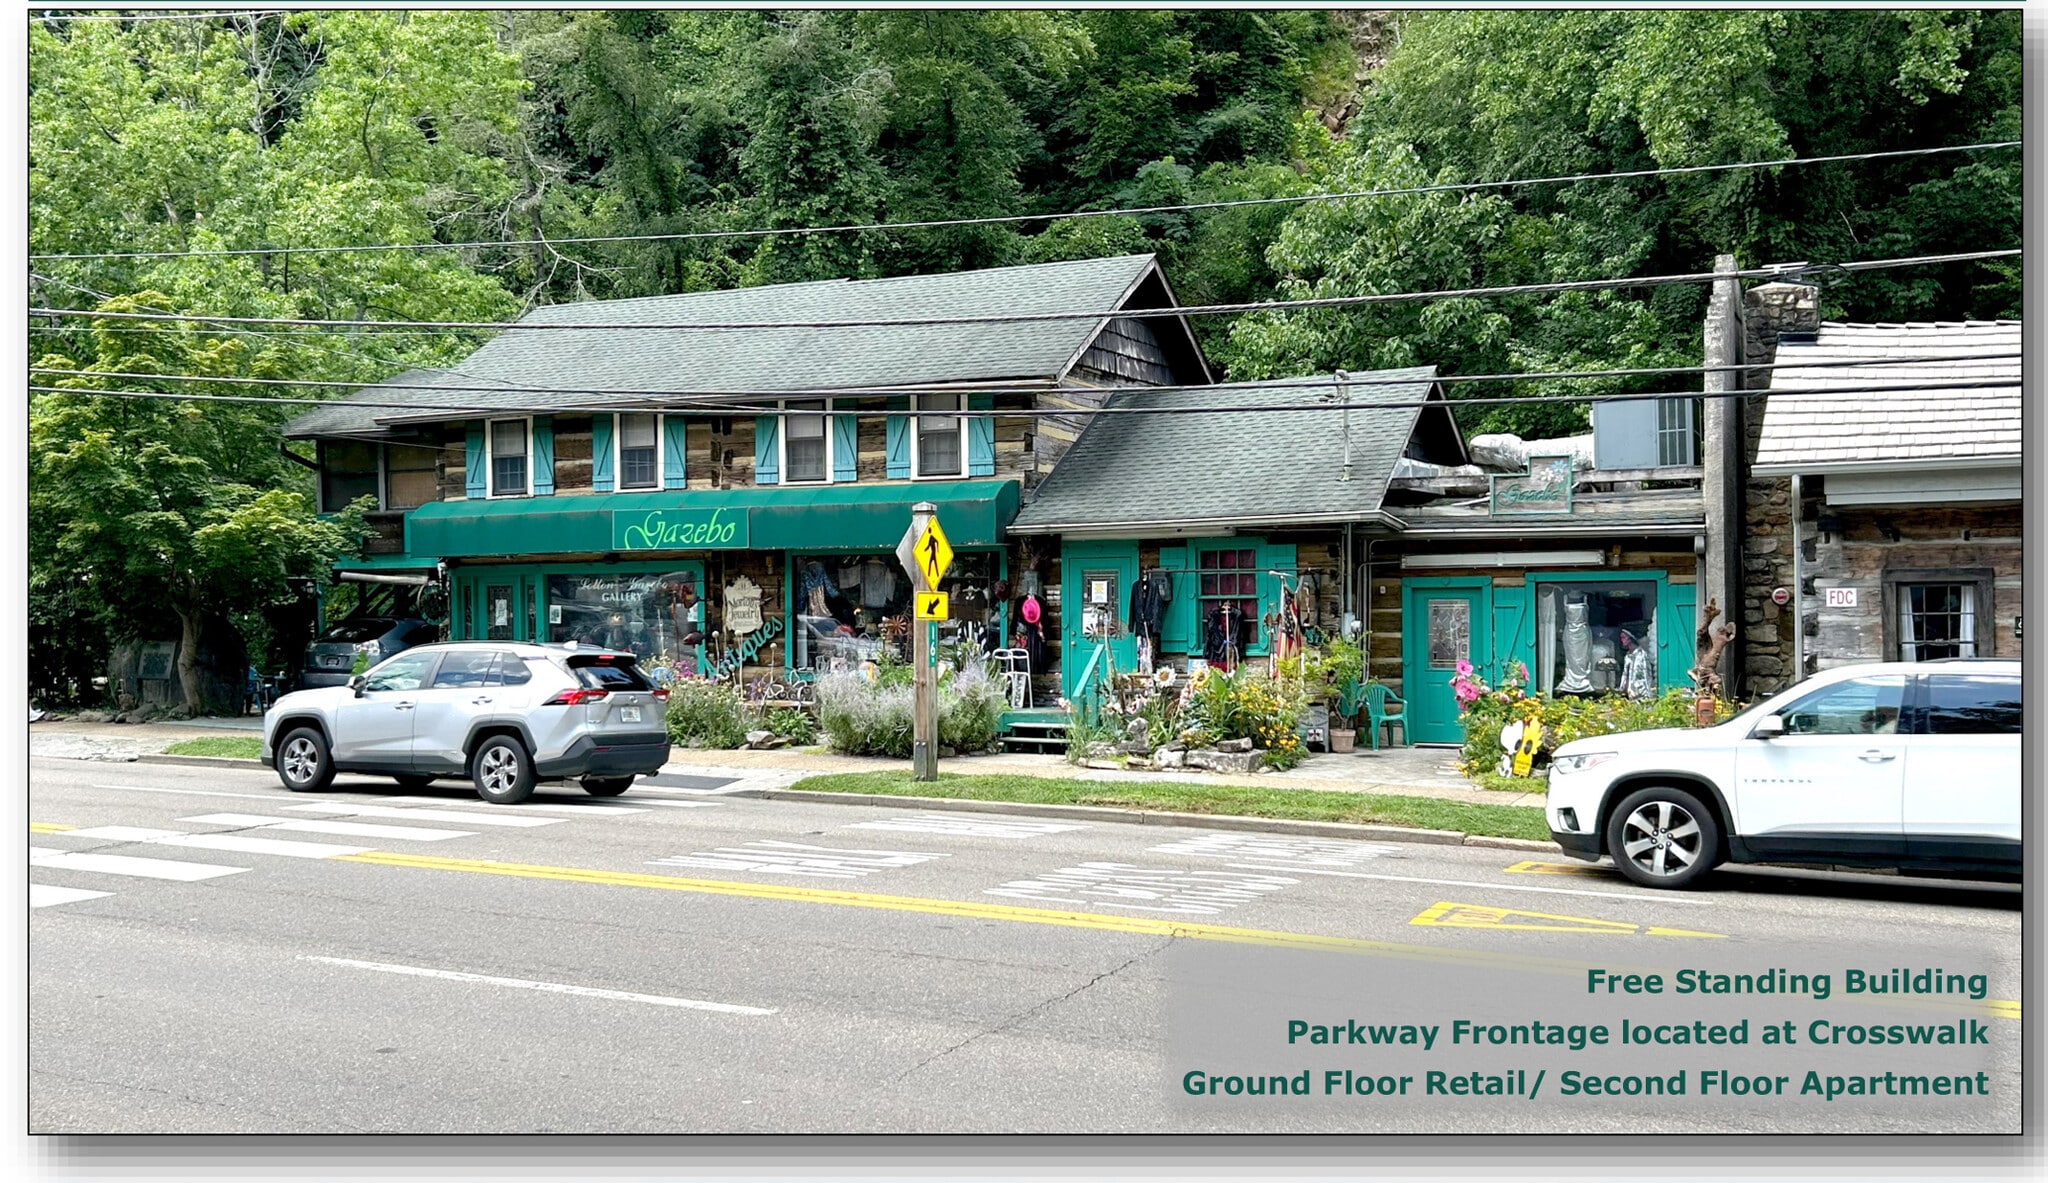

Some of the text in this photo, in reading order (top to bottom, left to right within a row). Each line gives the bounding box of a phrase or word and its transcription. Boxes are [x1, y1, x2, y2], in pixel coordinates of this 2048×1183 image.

[624, 507, 736, 549] Gazebo
[601, 592, 643, 602] GALLERY
[1829, 590, 1854, 605] FDC
[729, 607, 759, 620] Jewelry
